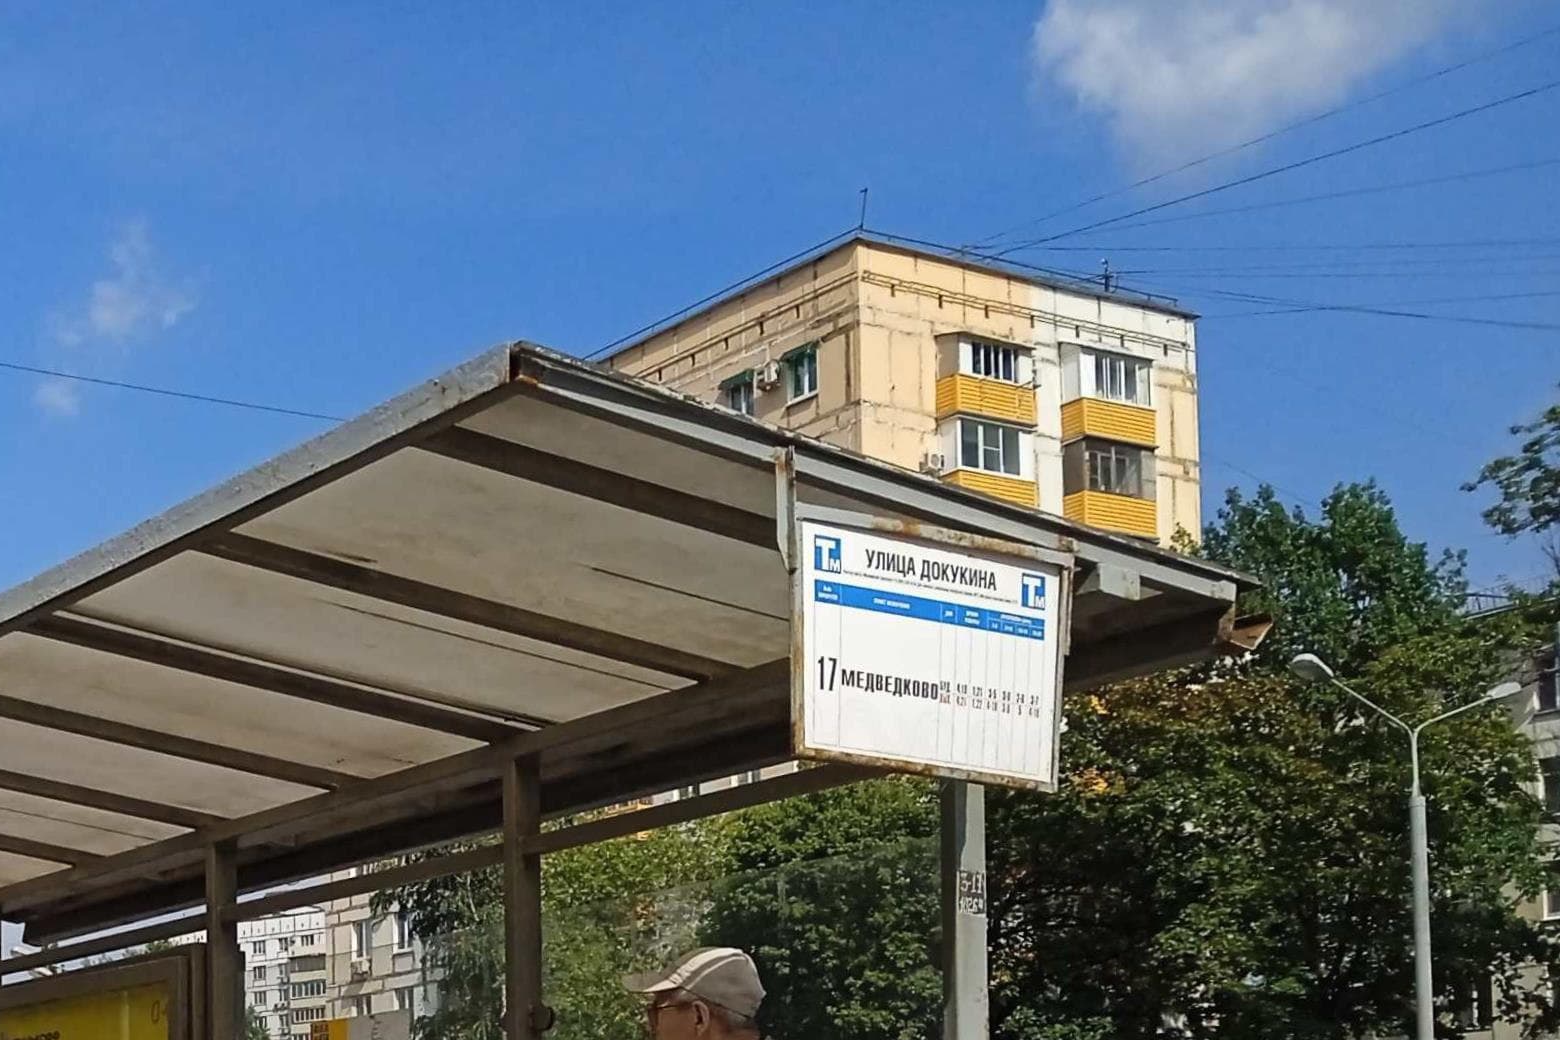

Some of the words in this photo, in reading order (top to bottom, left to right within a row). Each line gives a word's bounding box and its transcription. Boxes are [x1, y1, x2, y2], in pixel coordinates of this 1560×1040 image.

[865, 549, 915, 577] УЛИЦА
[920, 559, 997, 591] ДОКУКИНА
[818, 656, 837, 691] 17
[841, 668, 939, 700] МЕДВЕДКОВО
